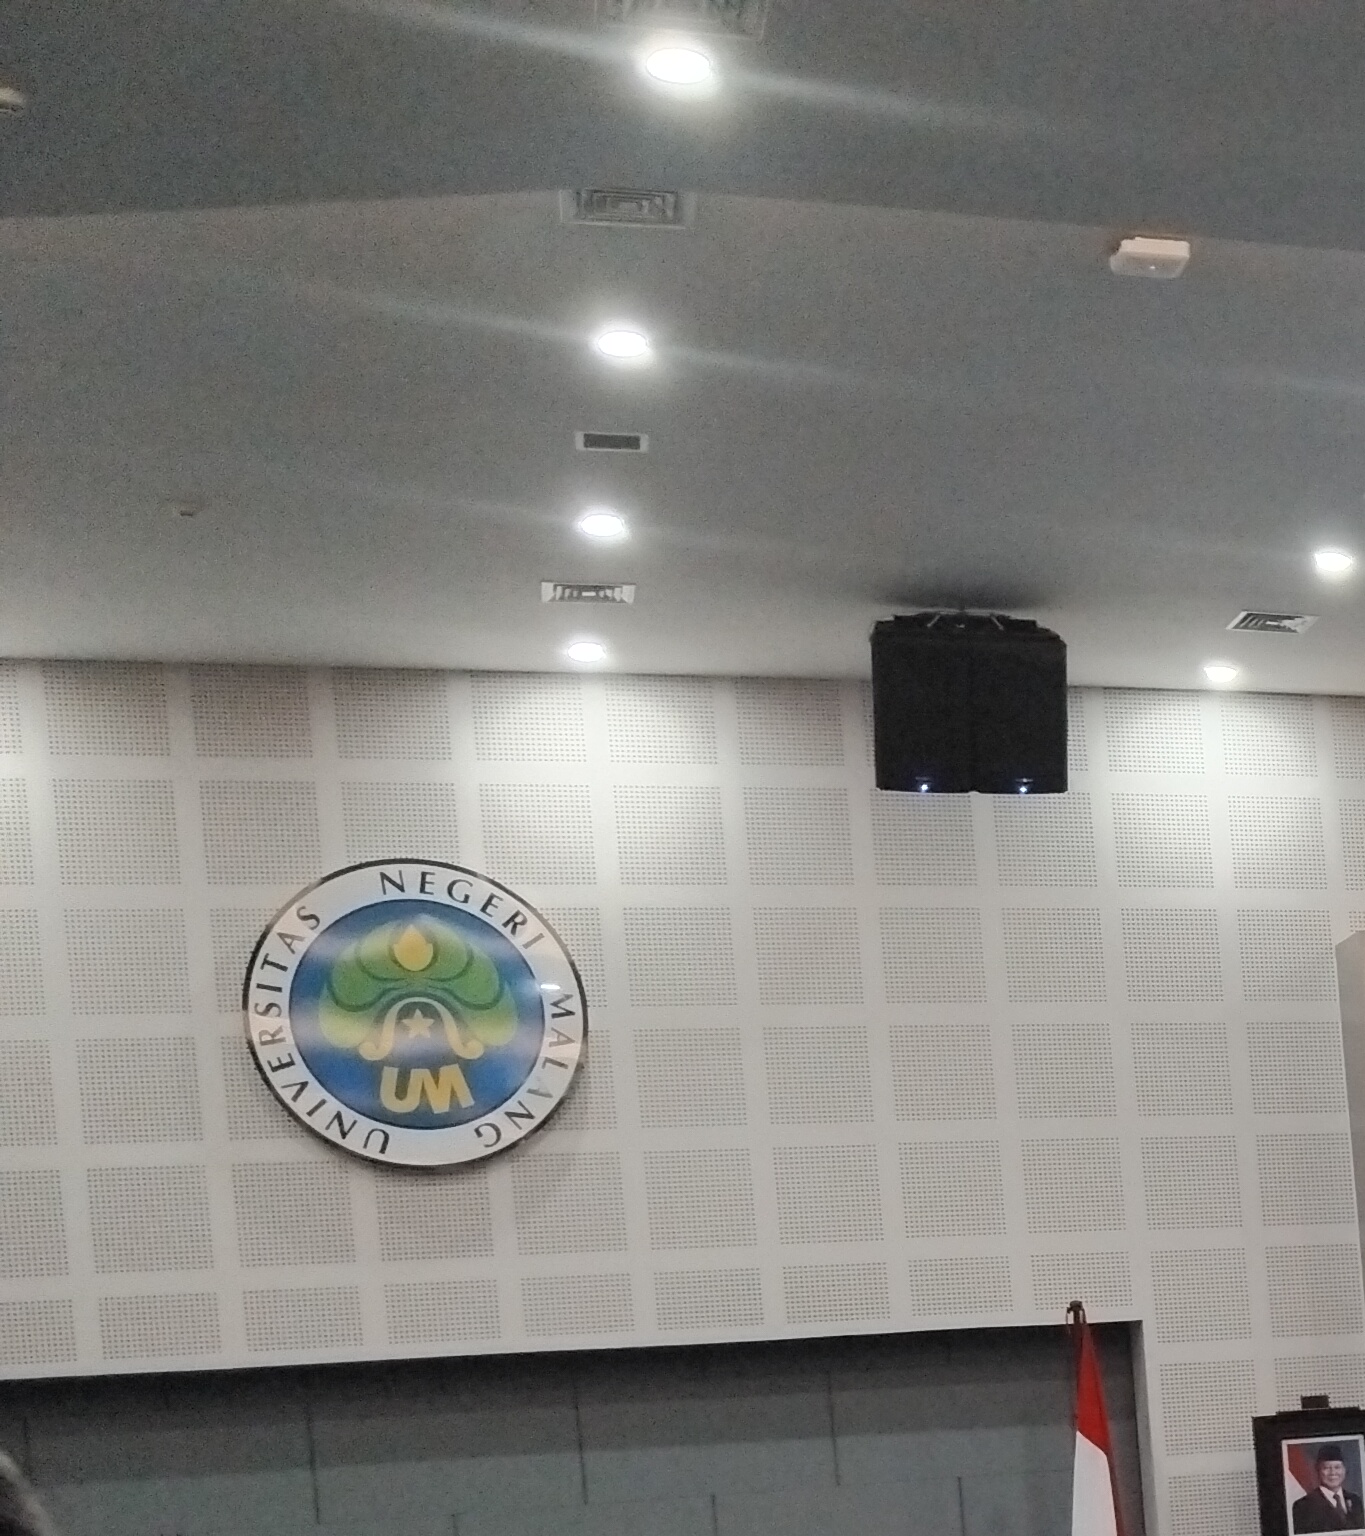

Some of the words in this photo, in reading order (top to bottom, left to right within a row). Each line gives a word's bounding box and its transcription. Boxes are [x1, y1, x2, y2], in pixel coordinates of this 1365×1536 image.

[254, 905, 391, 1155] UNIVERSITAS
[380, 869, 545, 950] NEGERI
[473, 991, 577, 1149] MALANG
[379, 1063, 475, 1115] UM
